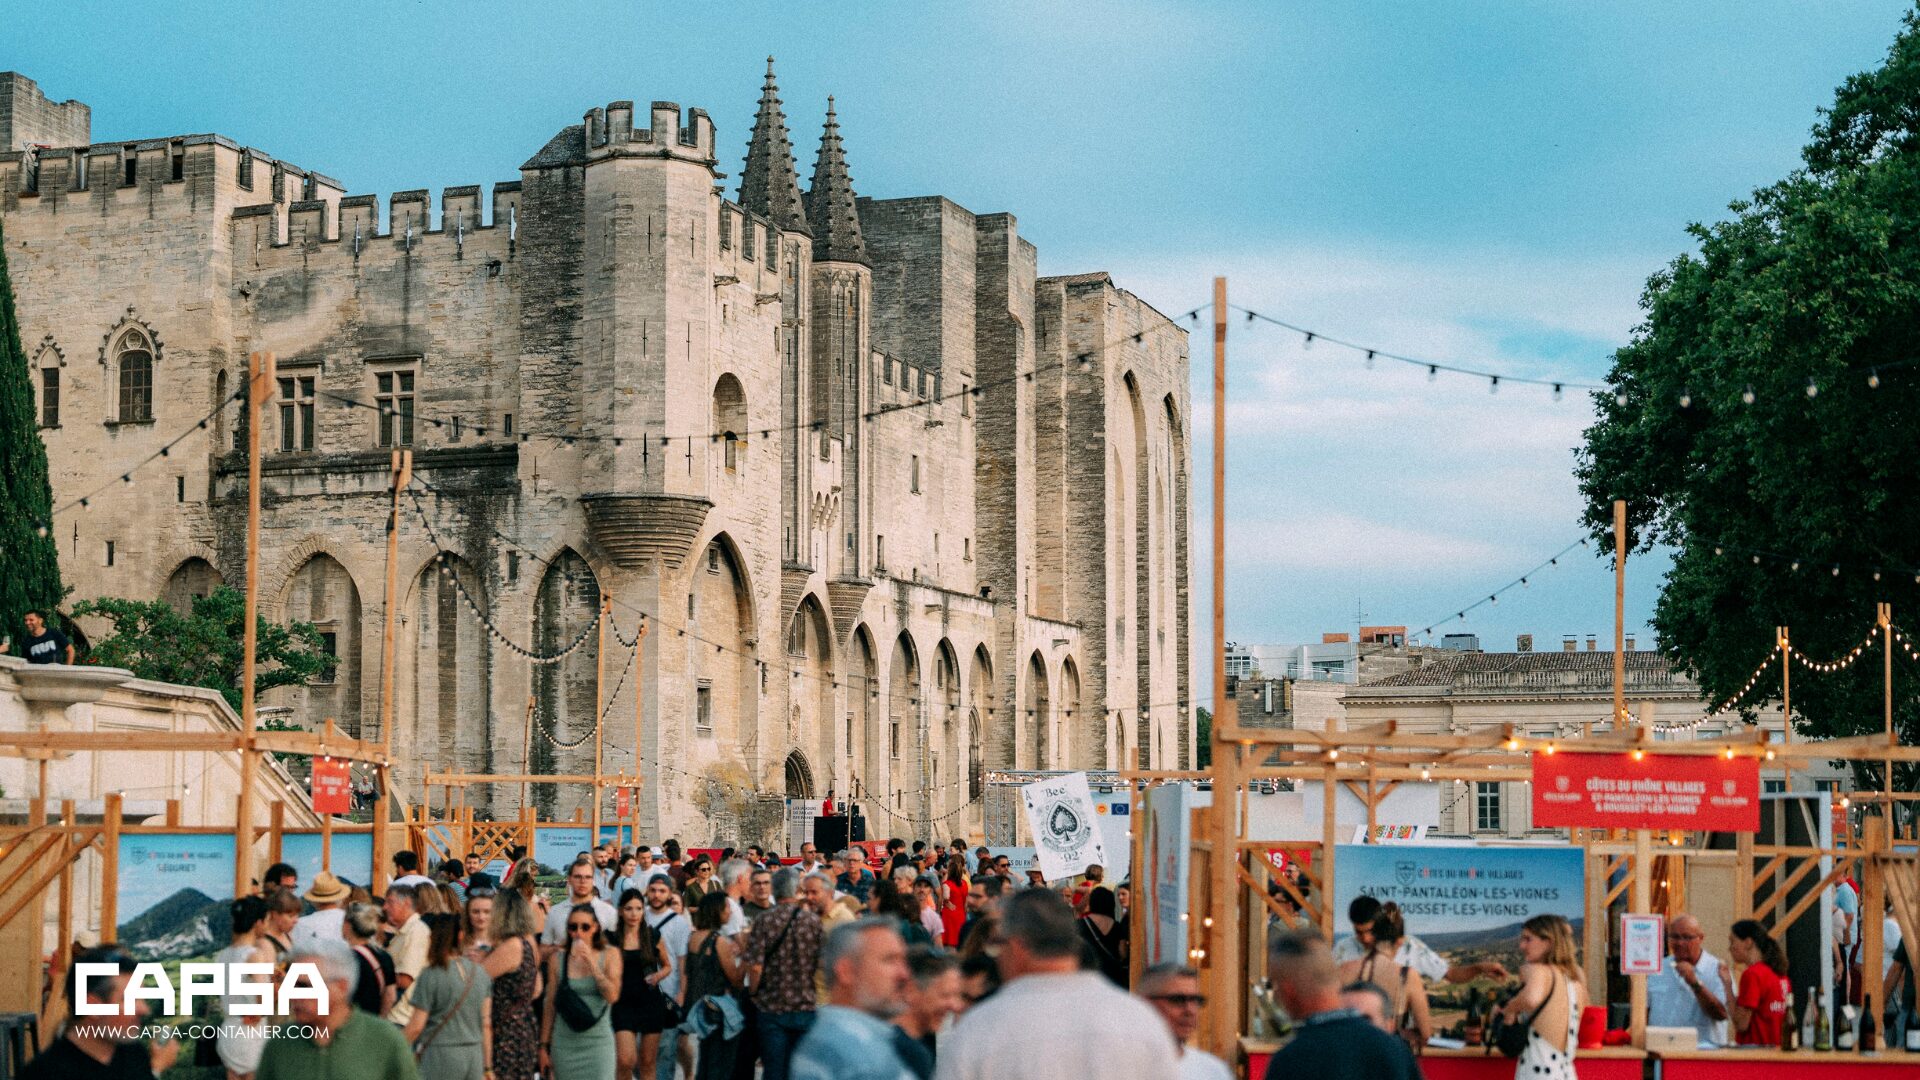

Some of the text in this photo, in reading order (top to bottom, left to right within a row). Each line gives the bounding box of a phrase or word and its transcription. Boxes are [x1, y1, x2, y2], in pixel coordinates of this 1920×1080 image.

[1617, 780, 1630, 792] DU
[1445, 868, 1457, 880] DU
[1488, 868, 1523, 880] VILLAGES
[1360, 884, 1559, 900] SAINT-PANTALÉON-LES-VIGNES
[1398, 902, 1528, 916] OUSSET-LES-VIGNES
